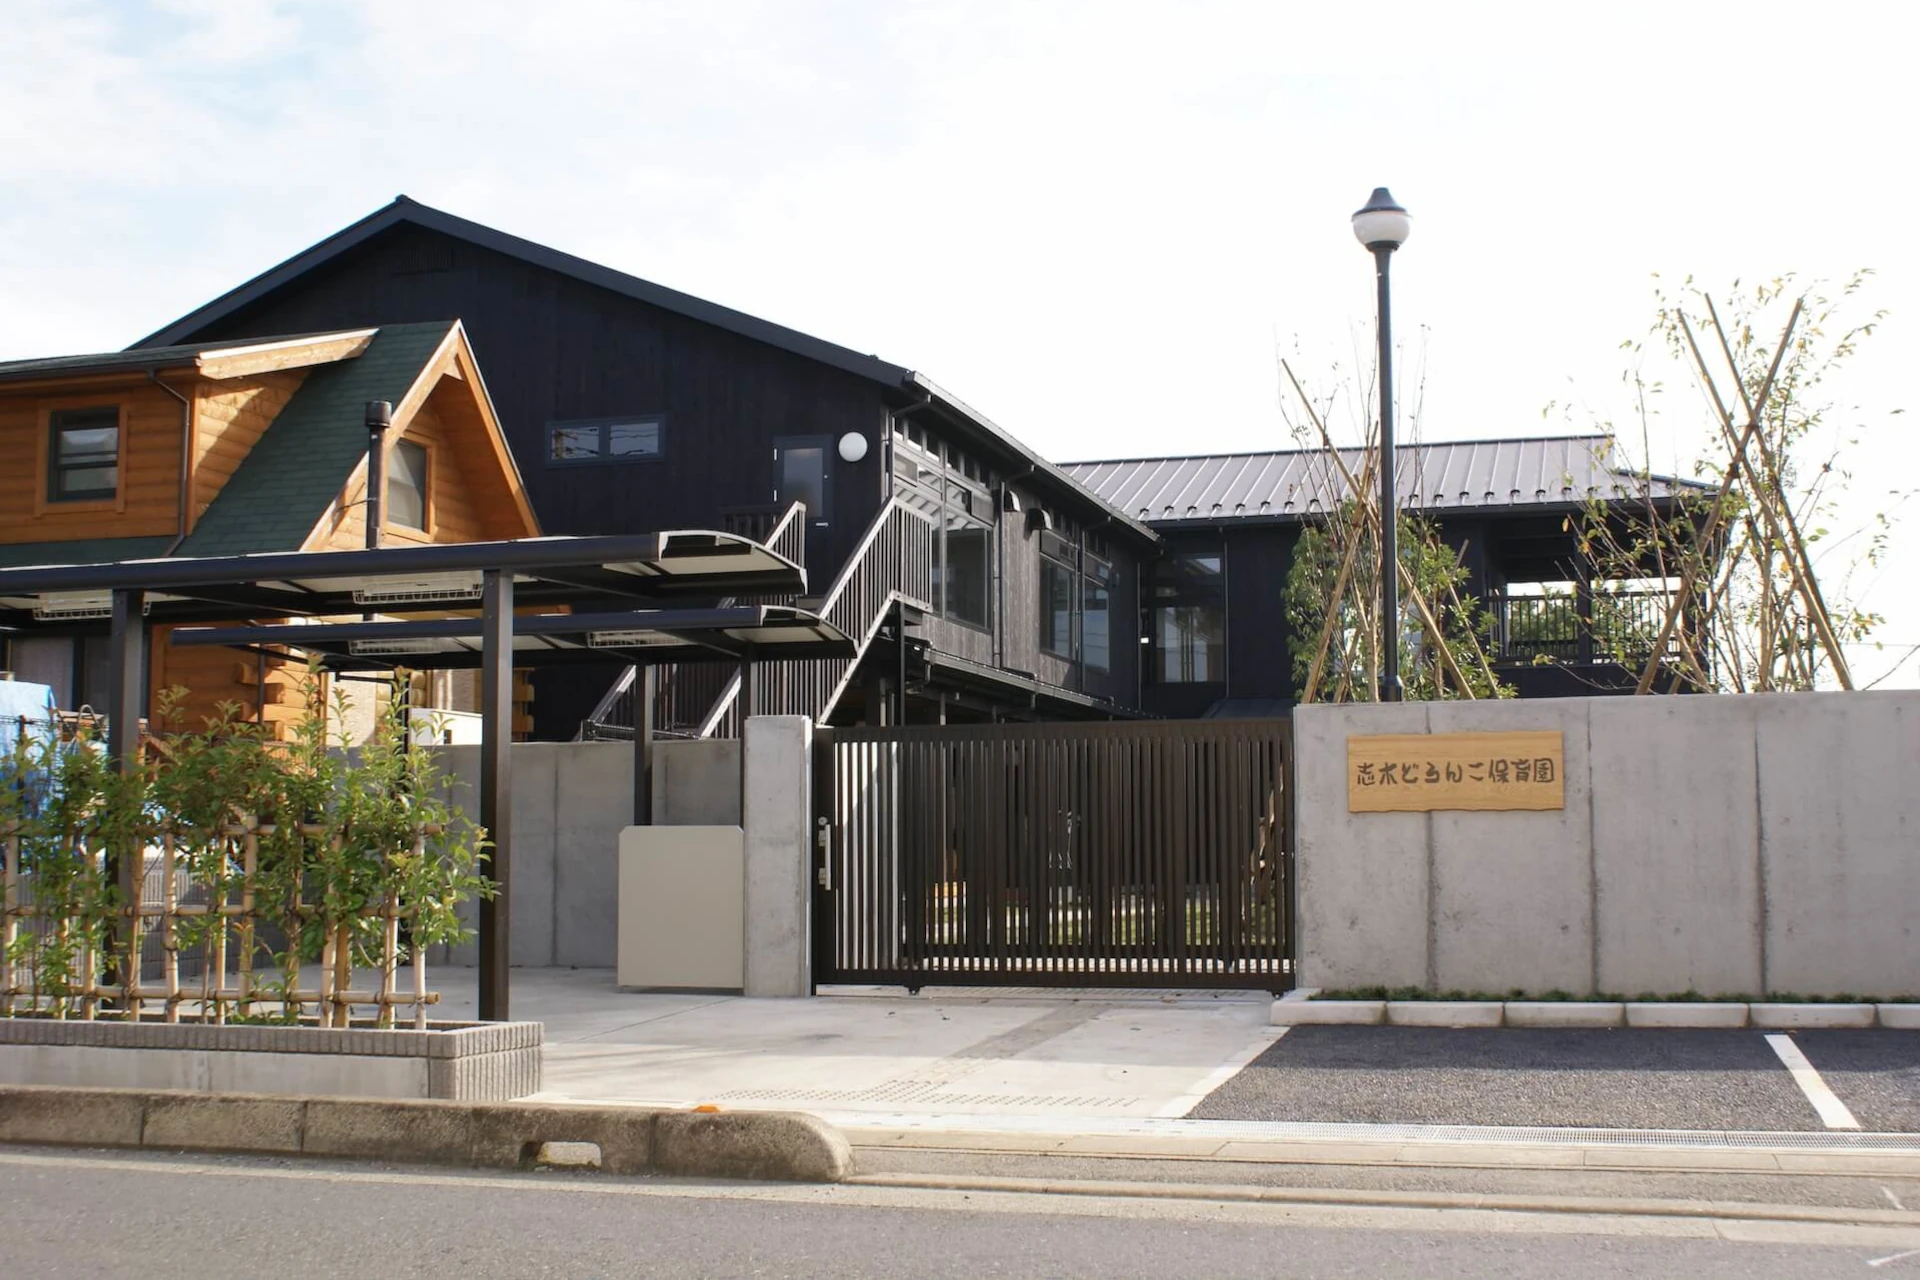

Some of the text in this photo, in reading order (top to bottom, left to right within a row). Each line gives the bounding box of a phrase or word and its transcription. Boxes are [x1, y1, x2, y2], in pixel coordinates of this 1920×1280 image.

[1356, 757, 1555, 786] 志木どろんこ保育園
